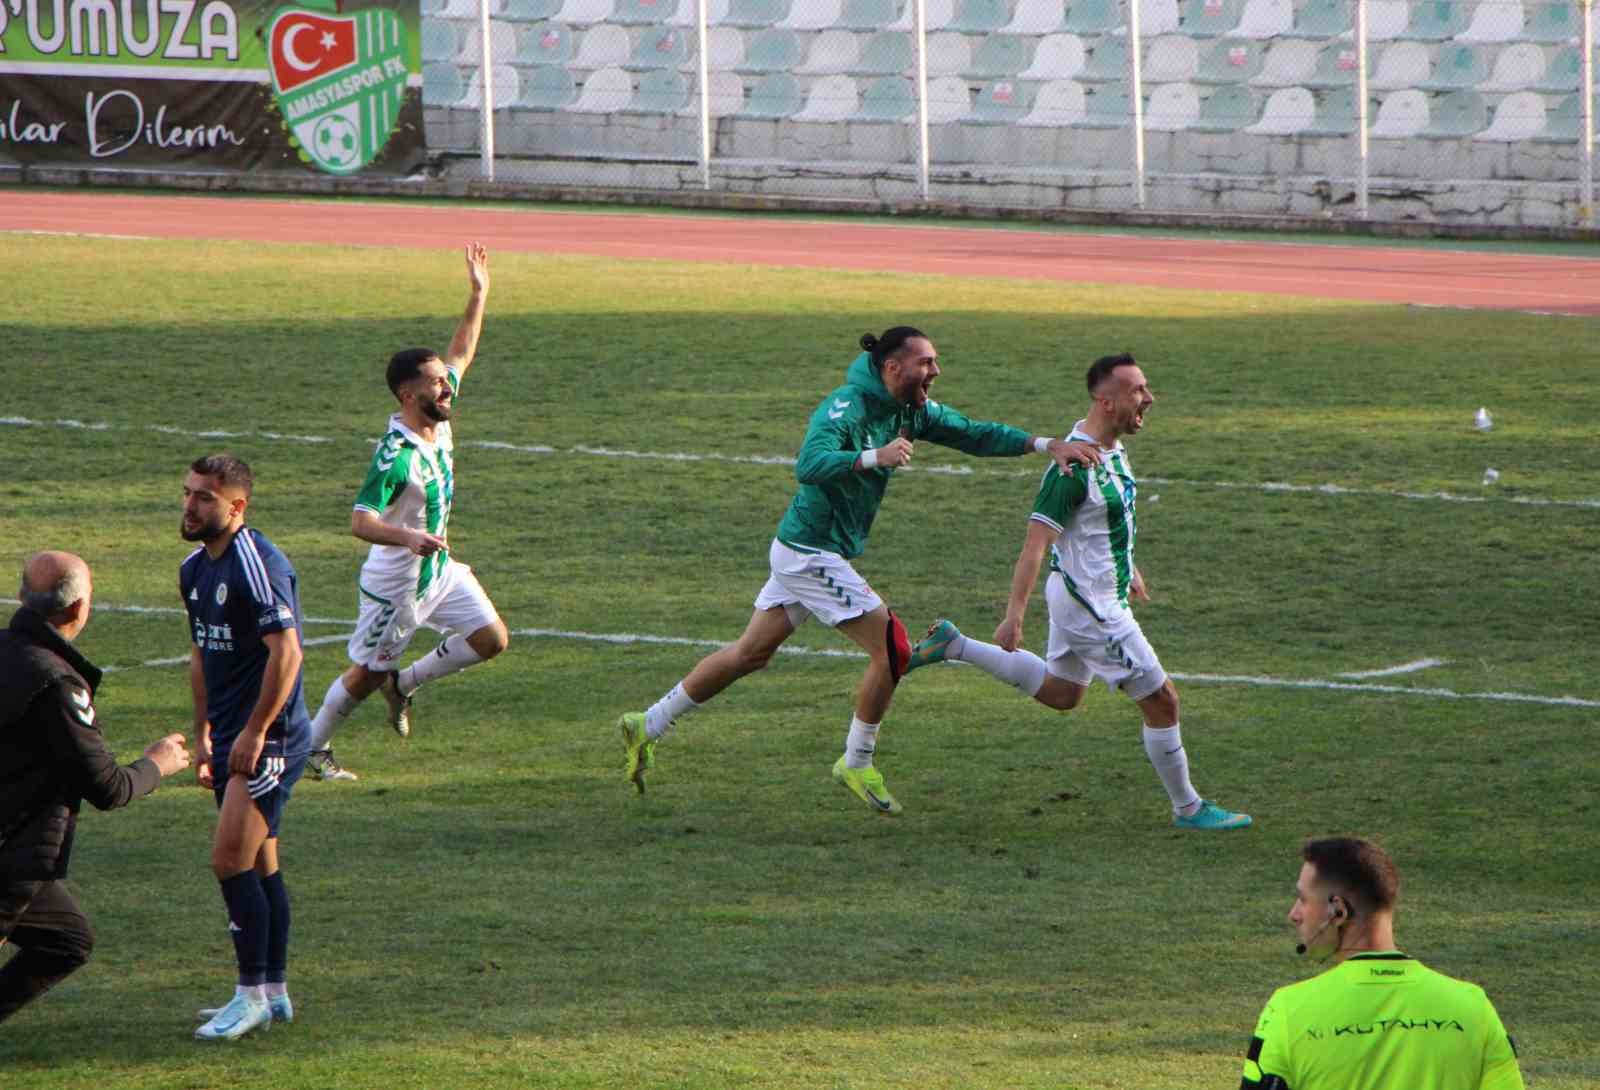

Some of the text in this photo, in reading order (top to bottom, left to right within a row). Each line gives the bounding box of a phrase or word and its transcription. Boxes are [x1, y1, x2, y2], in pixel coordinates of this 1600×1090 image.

[286, 55, 407, 121] AMASYASPOR FK
[85, 89, 245, 157] Dilerim
